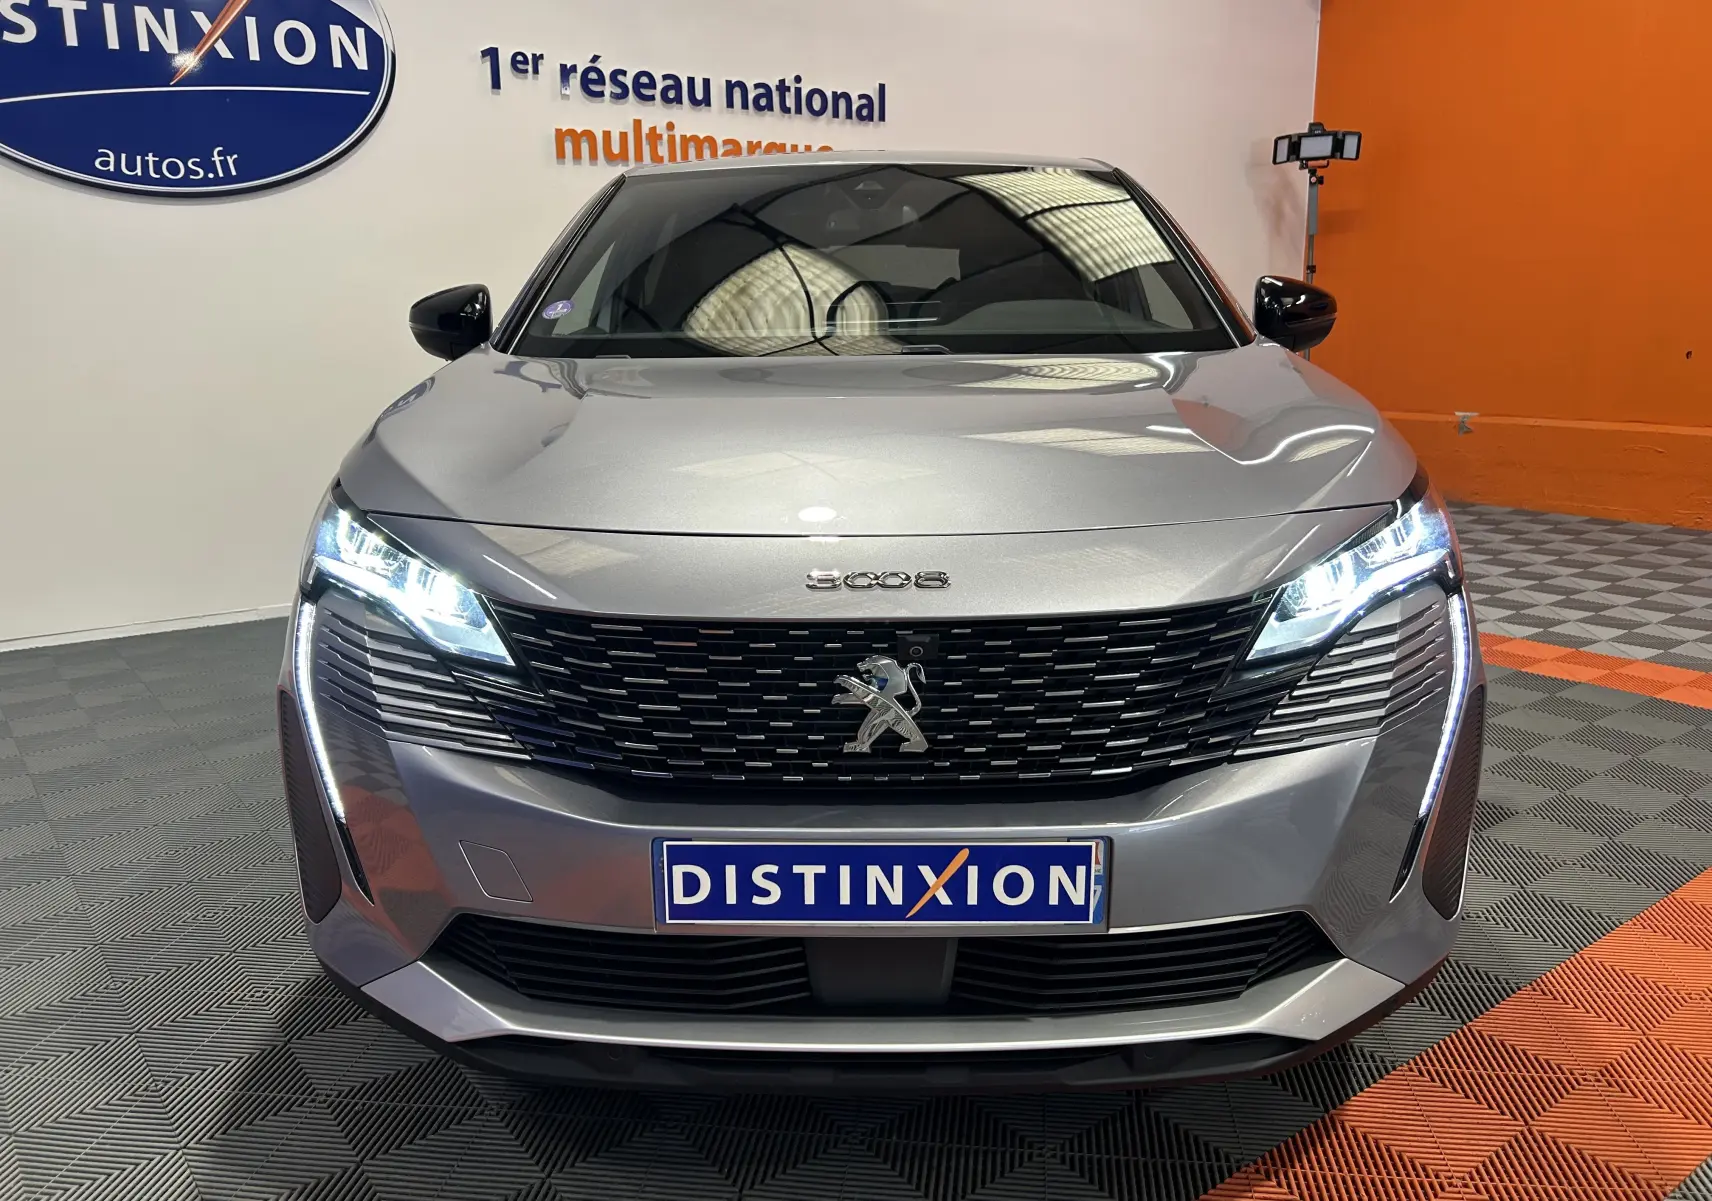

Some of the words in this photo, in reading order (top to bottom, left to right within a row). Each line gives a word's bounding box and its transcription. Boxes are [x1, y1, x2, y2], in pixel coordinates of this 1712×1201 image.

[480, 46, 545, 91] 1er
[559, 54, 711, 107] réseau
[725, 75, 886, 122] national
[94, 146, 238, 180] autos.fr
[554, 118, 834, 164] multimar
[806, 570, 951, 589] 3008
[672, 848, 1087, 919] DISTINXION
